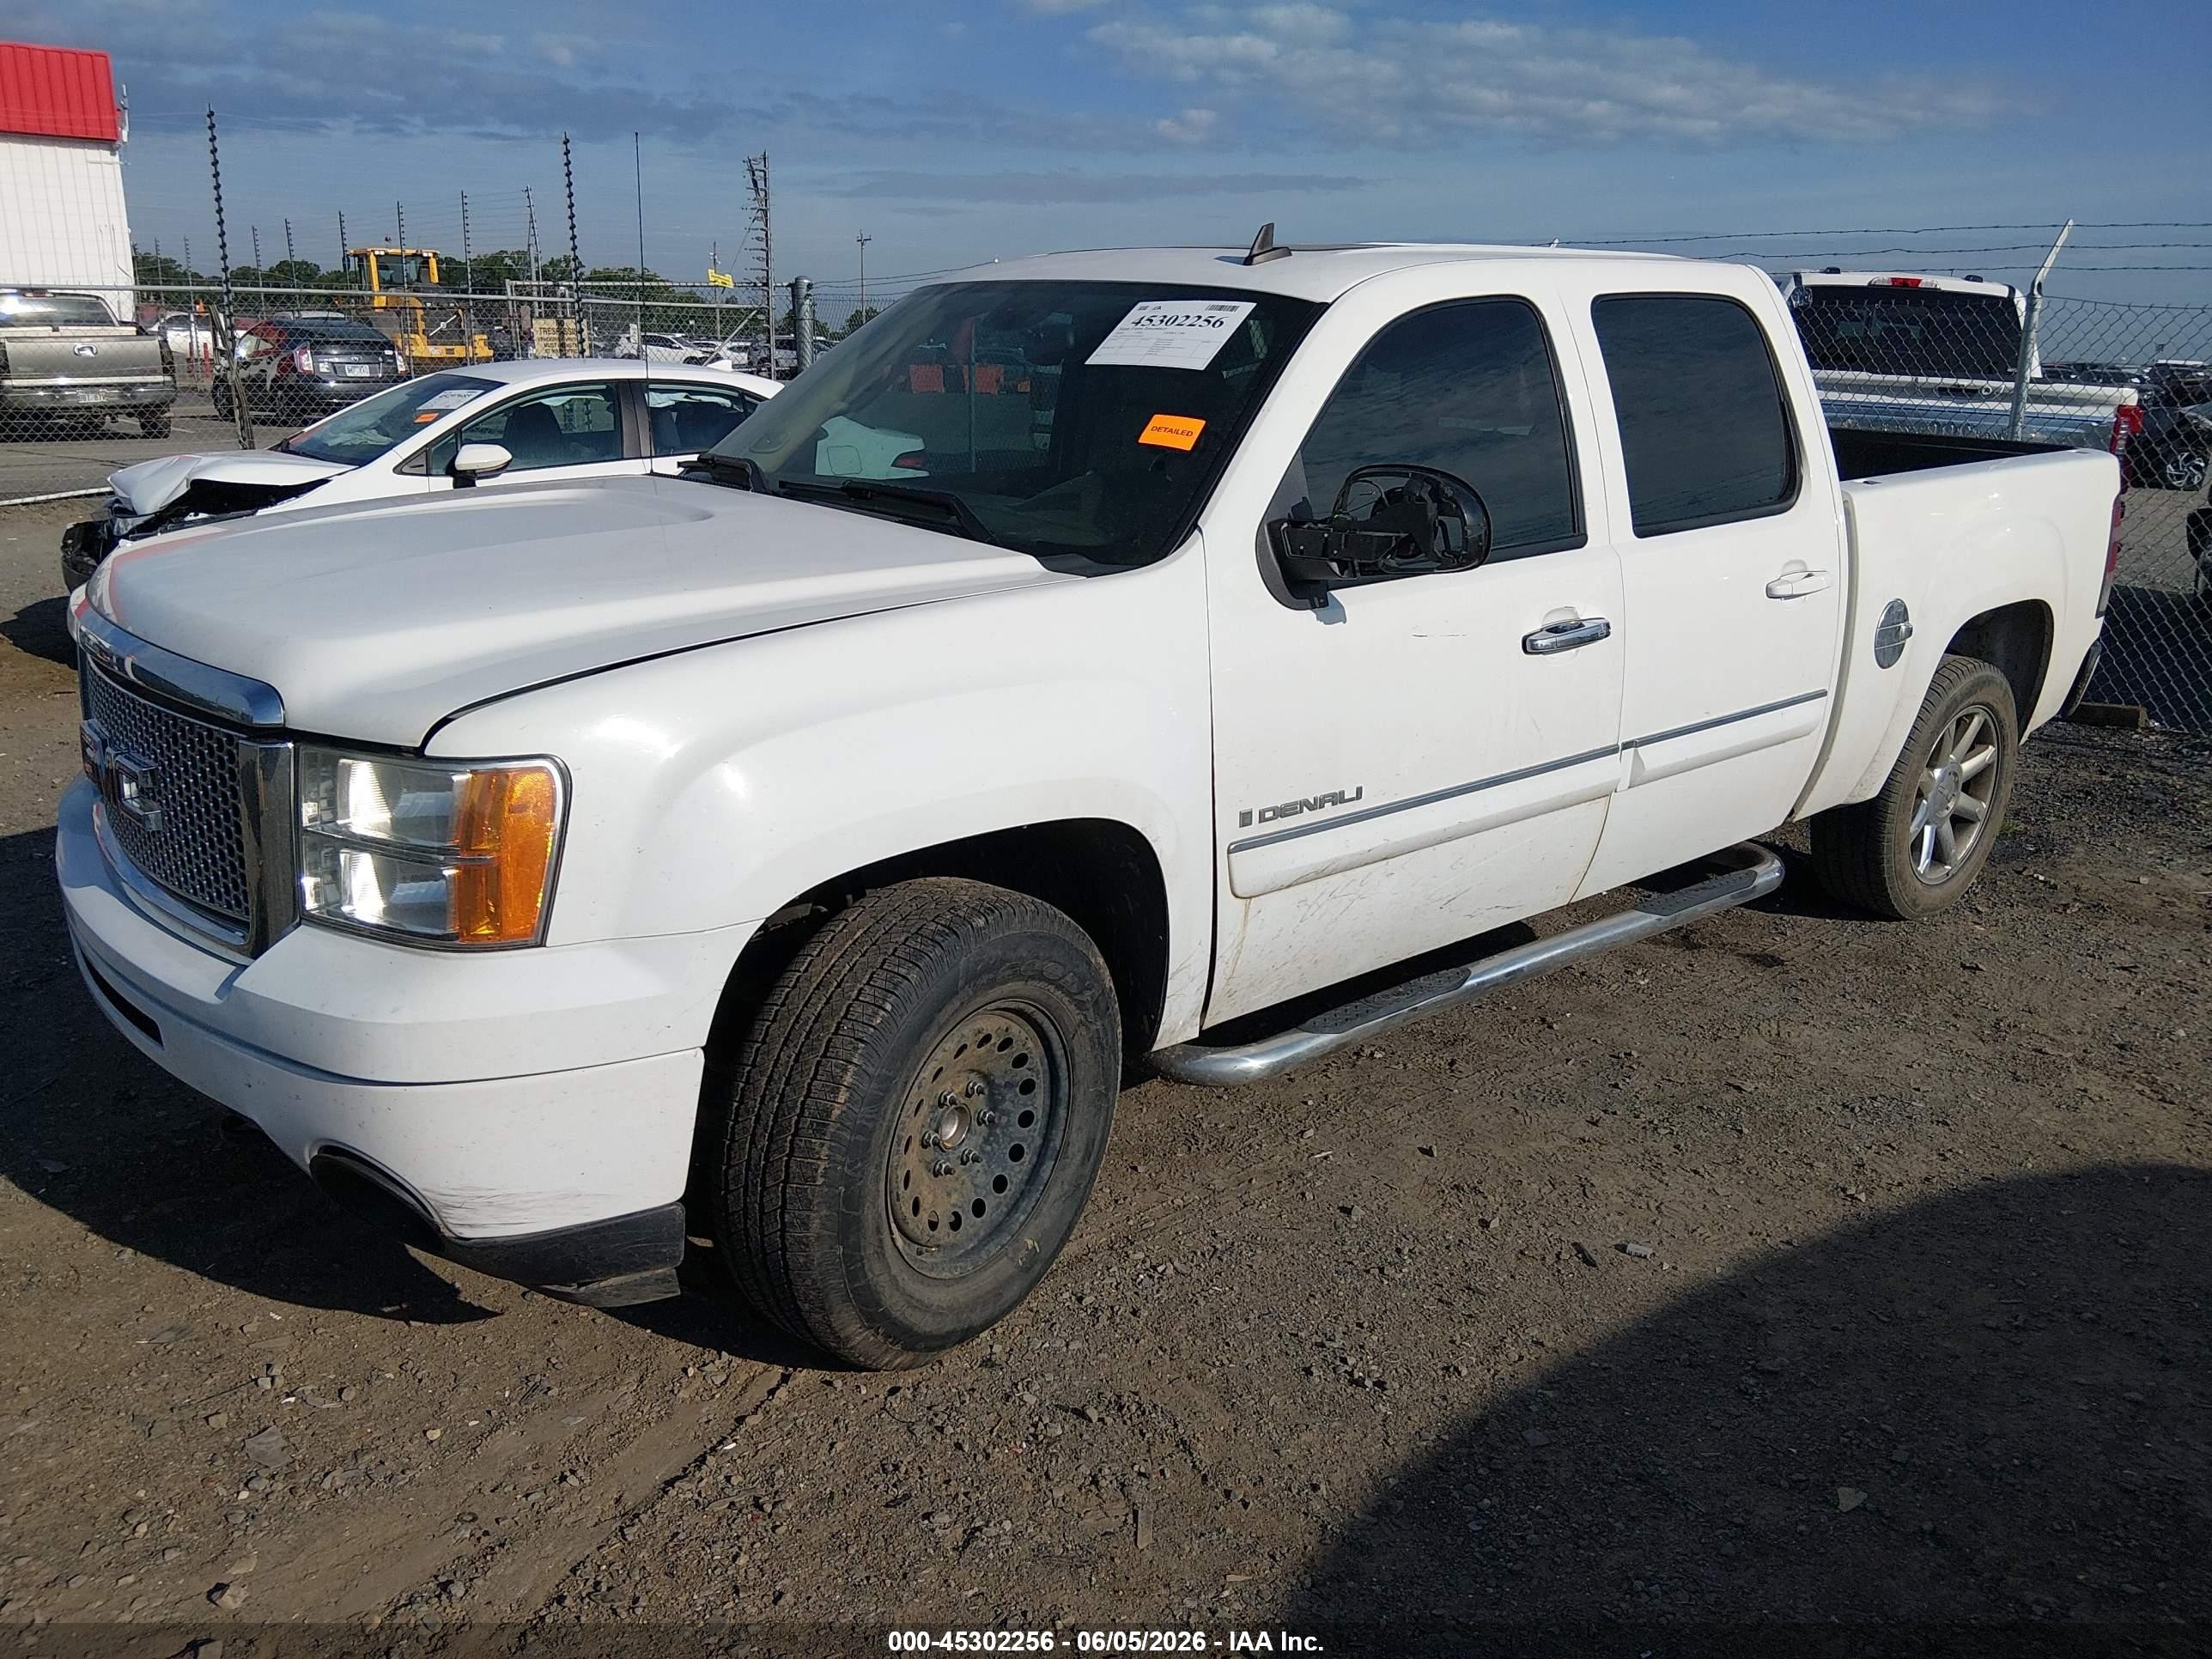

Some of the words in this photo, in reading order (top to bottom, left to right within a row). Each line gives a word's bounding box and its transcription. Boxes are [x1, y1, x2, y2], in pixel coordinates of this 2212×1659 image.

[1131, 314, 1228, 329] 45302256
[1151, 425, 1194, 438] DETAILED
[1259, 785, 1364, 824] DENALI
